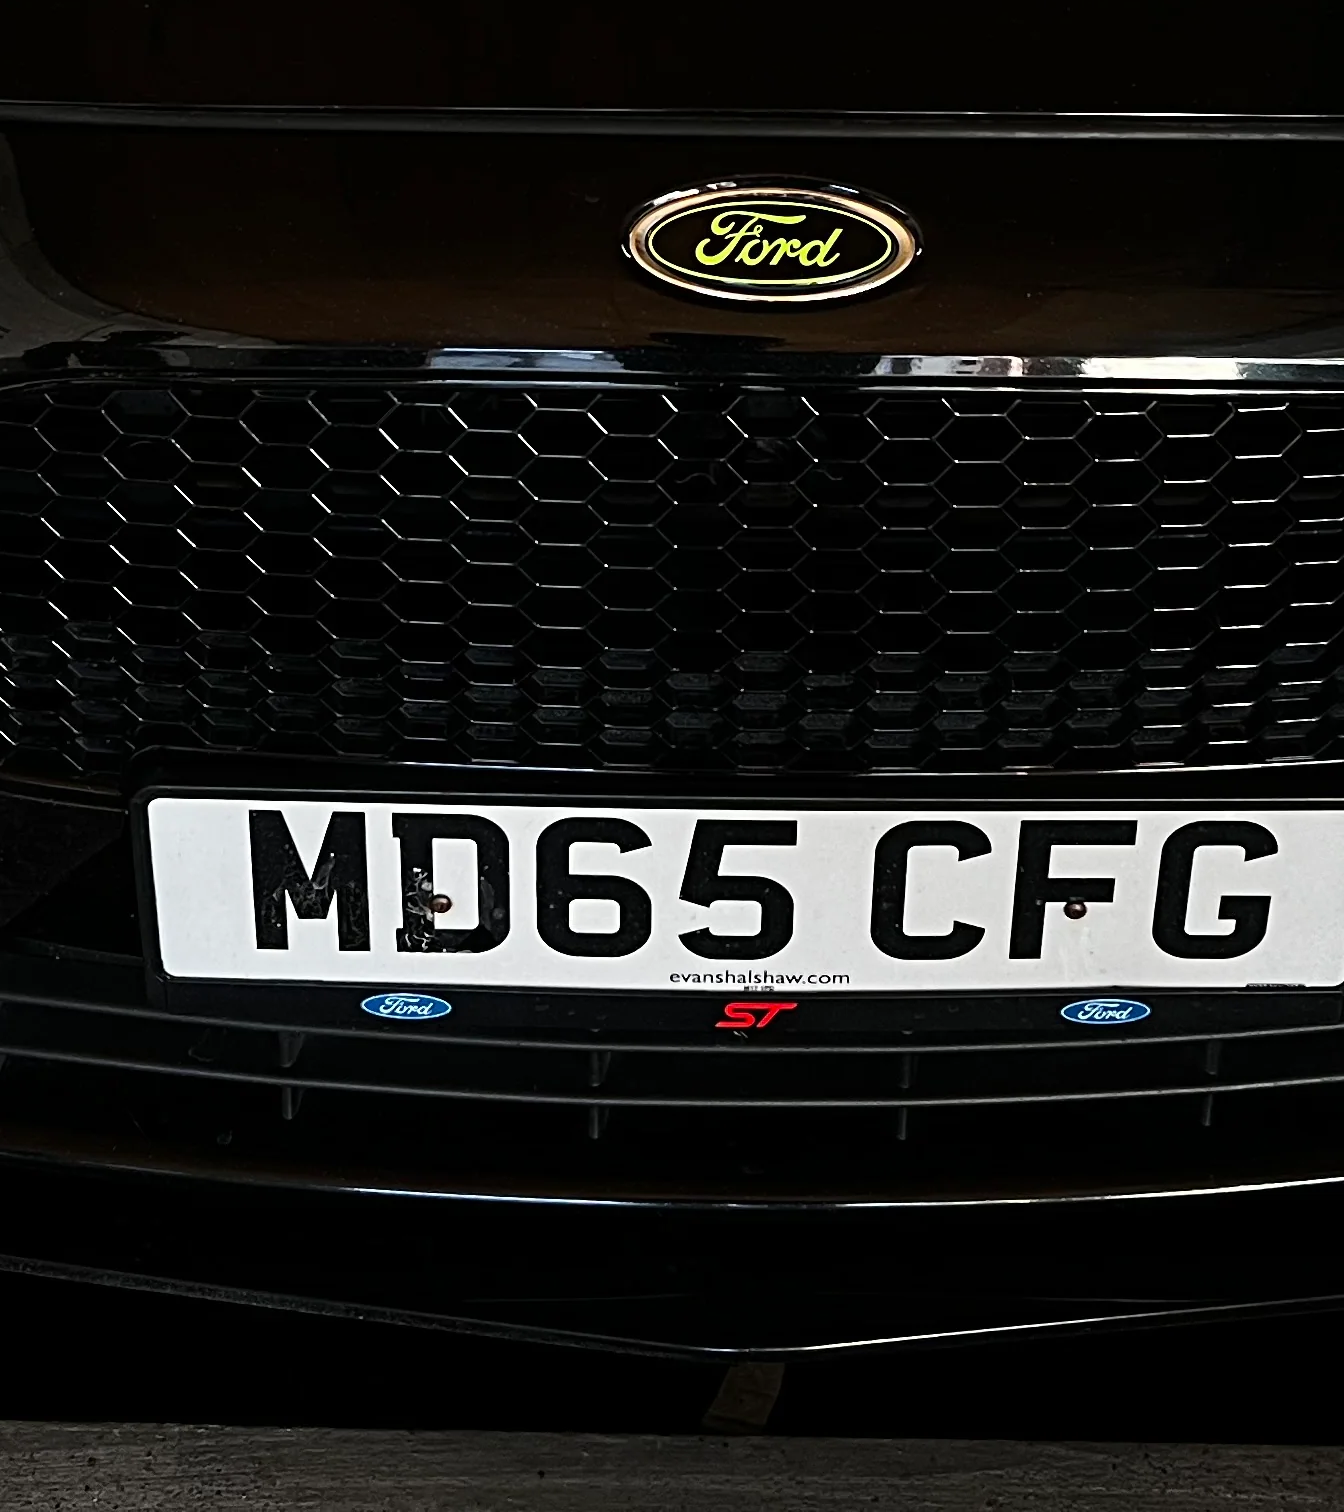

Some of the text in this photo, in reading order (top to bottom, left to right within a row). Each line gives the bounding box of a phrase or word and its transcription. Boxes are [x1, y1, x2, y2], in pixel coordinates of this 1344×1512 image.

[695, 211, 844, 267] Ford
[249, 810, 1278, 960] MD65 CFG
[669, 970, 850, 984] evanshalshaw.com
[379, 996, 434, 1015] Ford
[714, 1002, 799, 1028] ST
[1078, 1002, 1133, 1020] Ford
